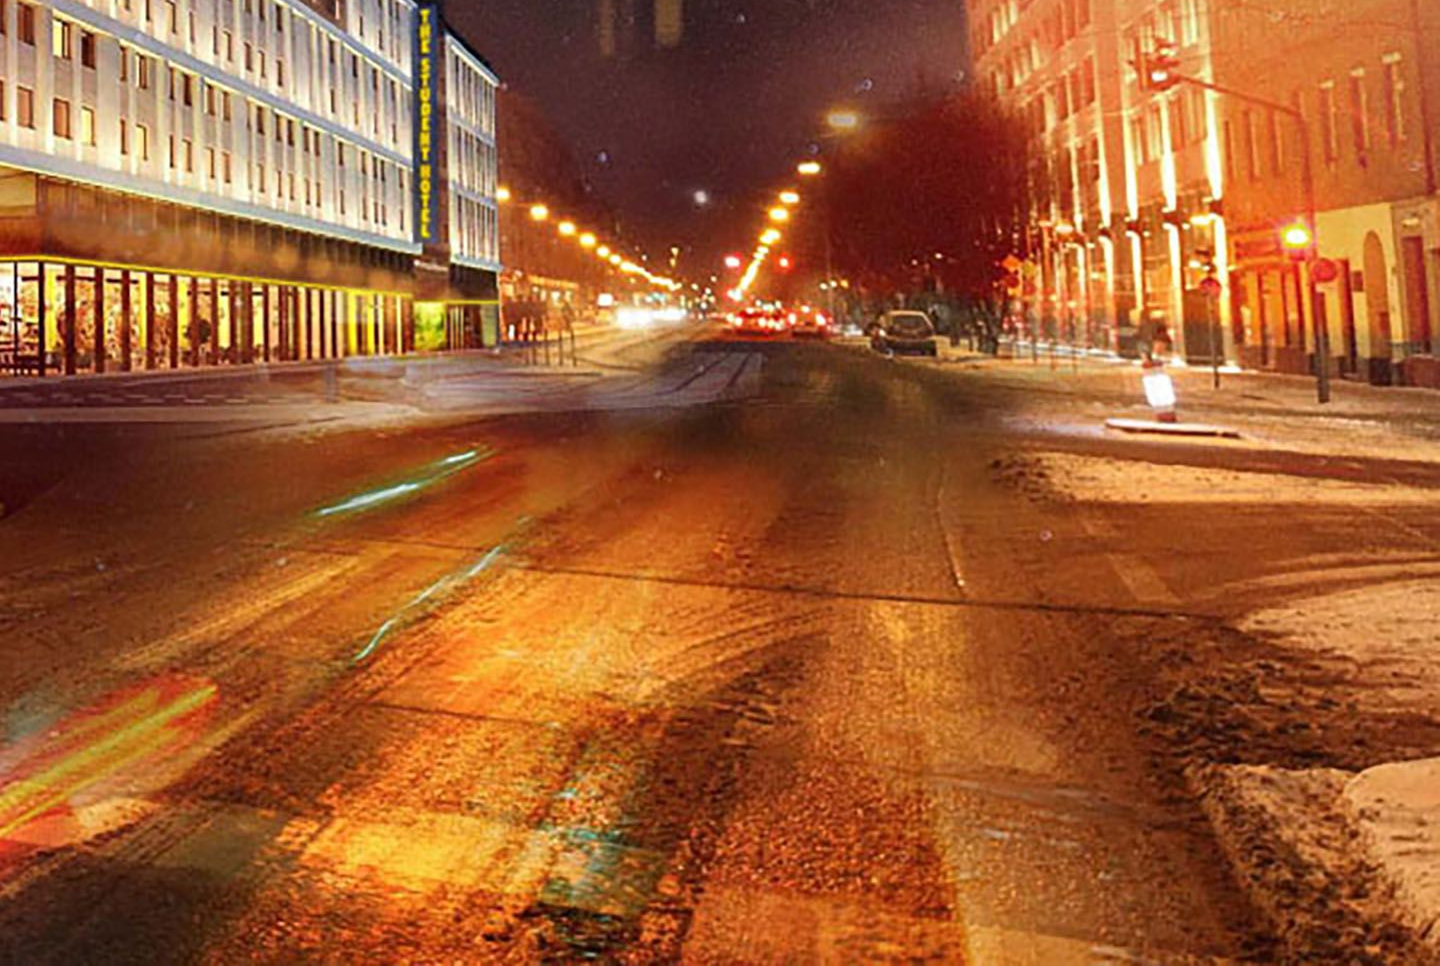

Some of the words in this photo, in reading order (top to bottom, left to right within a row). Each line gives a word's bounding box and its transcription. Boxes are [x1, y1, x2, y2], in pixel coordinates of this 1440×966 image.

[419, 9, 430, 54] THE
[419, 57, 432, 161] STUDENT
[419, 165, 431, 239] HOTEL
